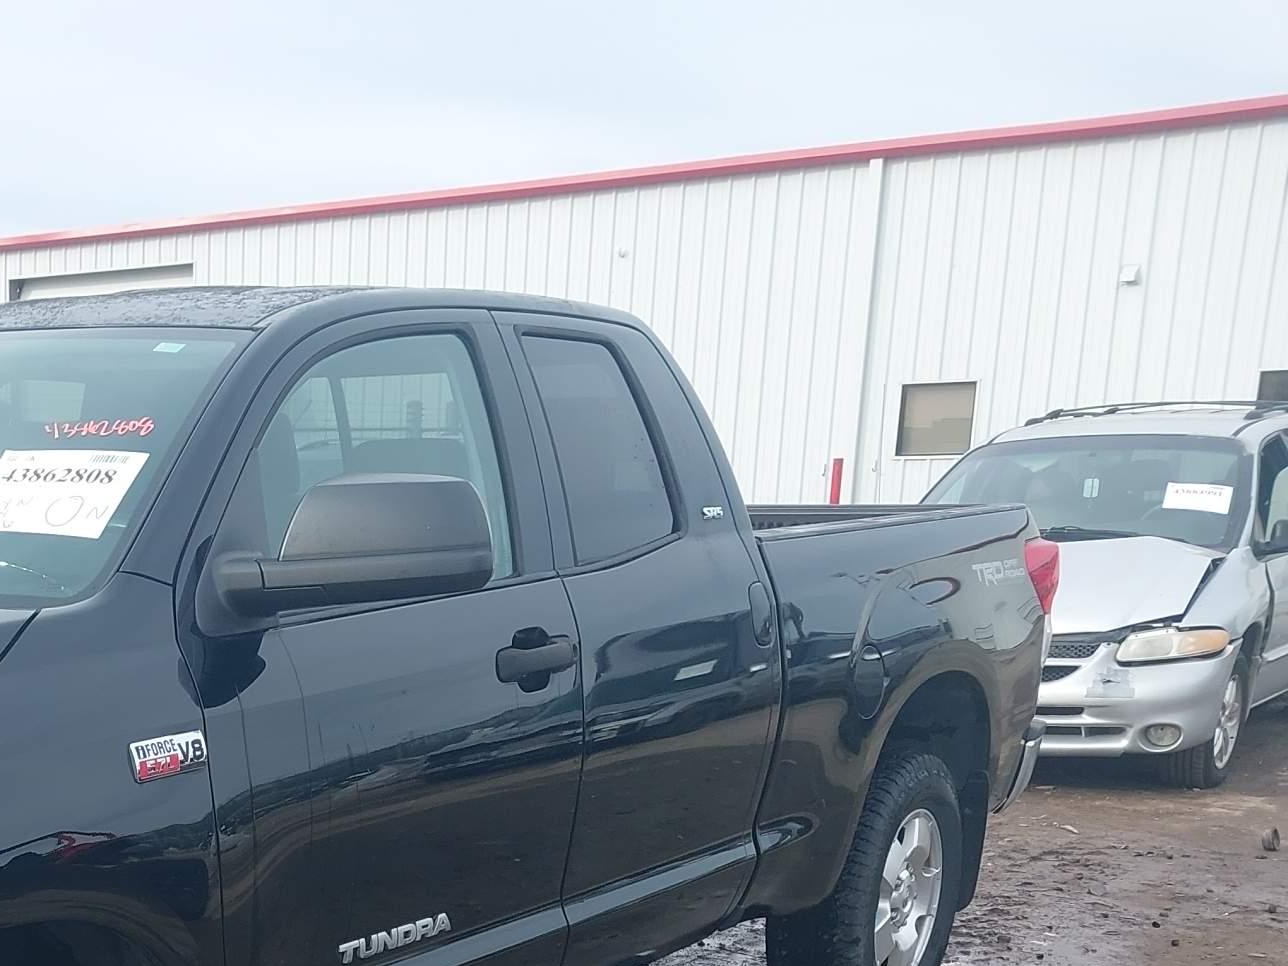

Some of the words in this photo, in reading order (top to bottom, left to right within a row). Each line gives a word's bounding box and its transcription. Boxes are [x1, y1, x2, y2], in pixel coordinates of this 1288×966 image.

[1, 468, 118, 485] 43862808
[702, 506, 724, 520] SR5
[972, 561, 1004, 586] TRD
[178, 738, 205, 763] V8
[338, 912, 452, 964] TUNDRA
